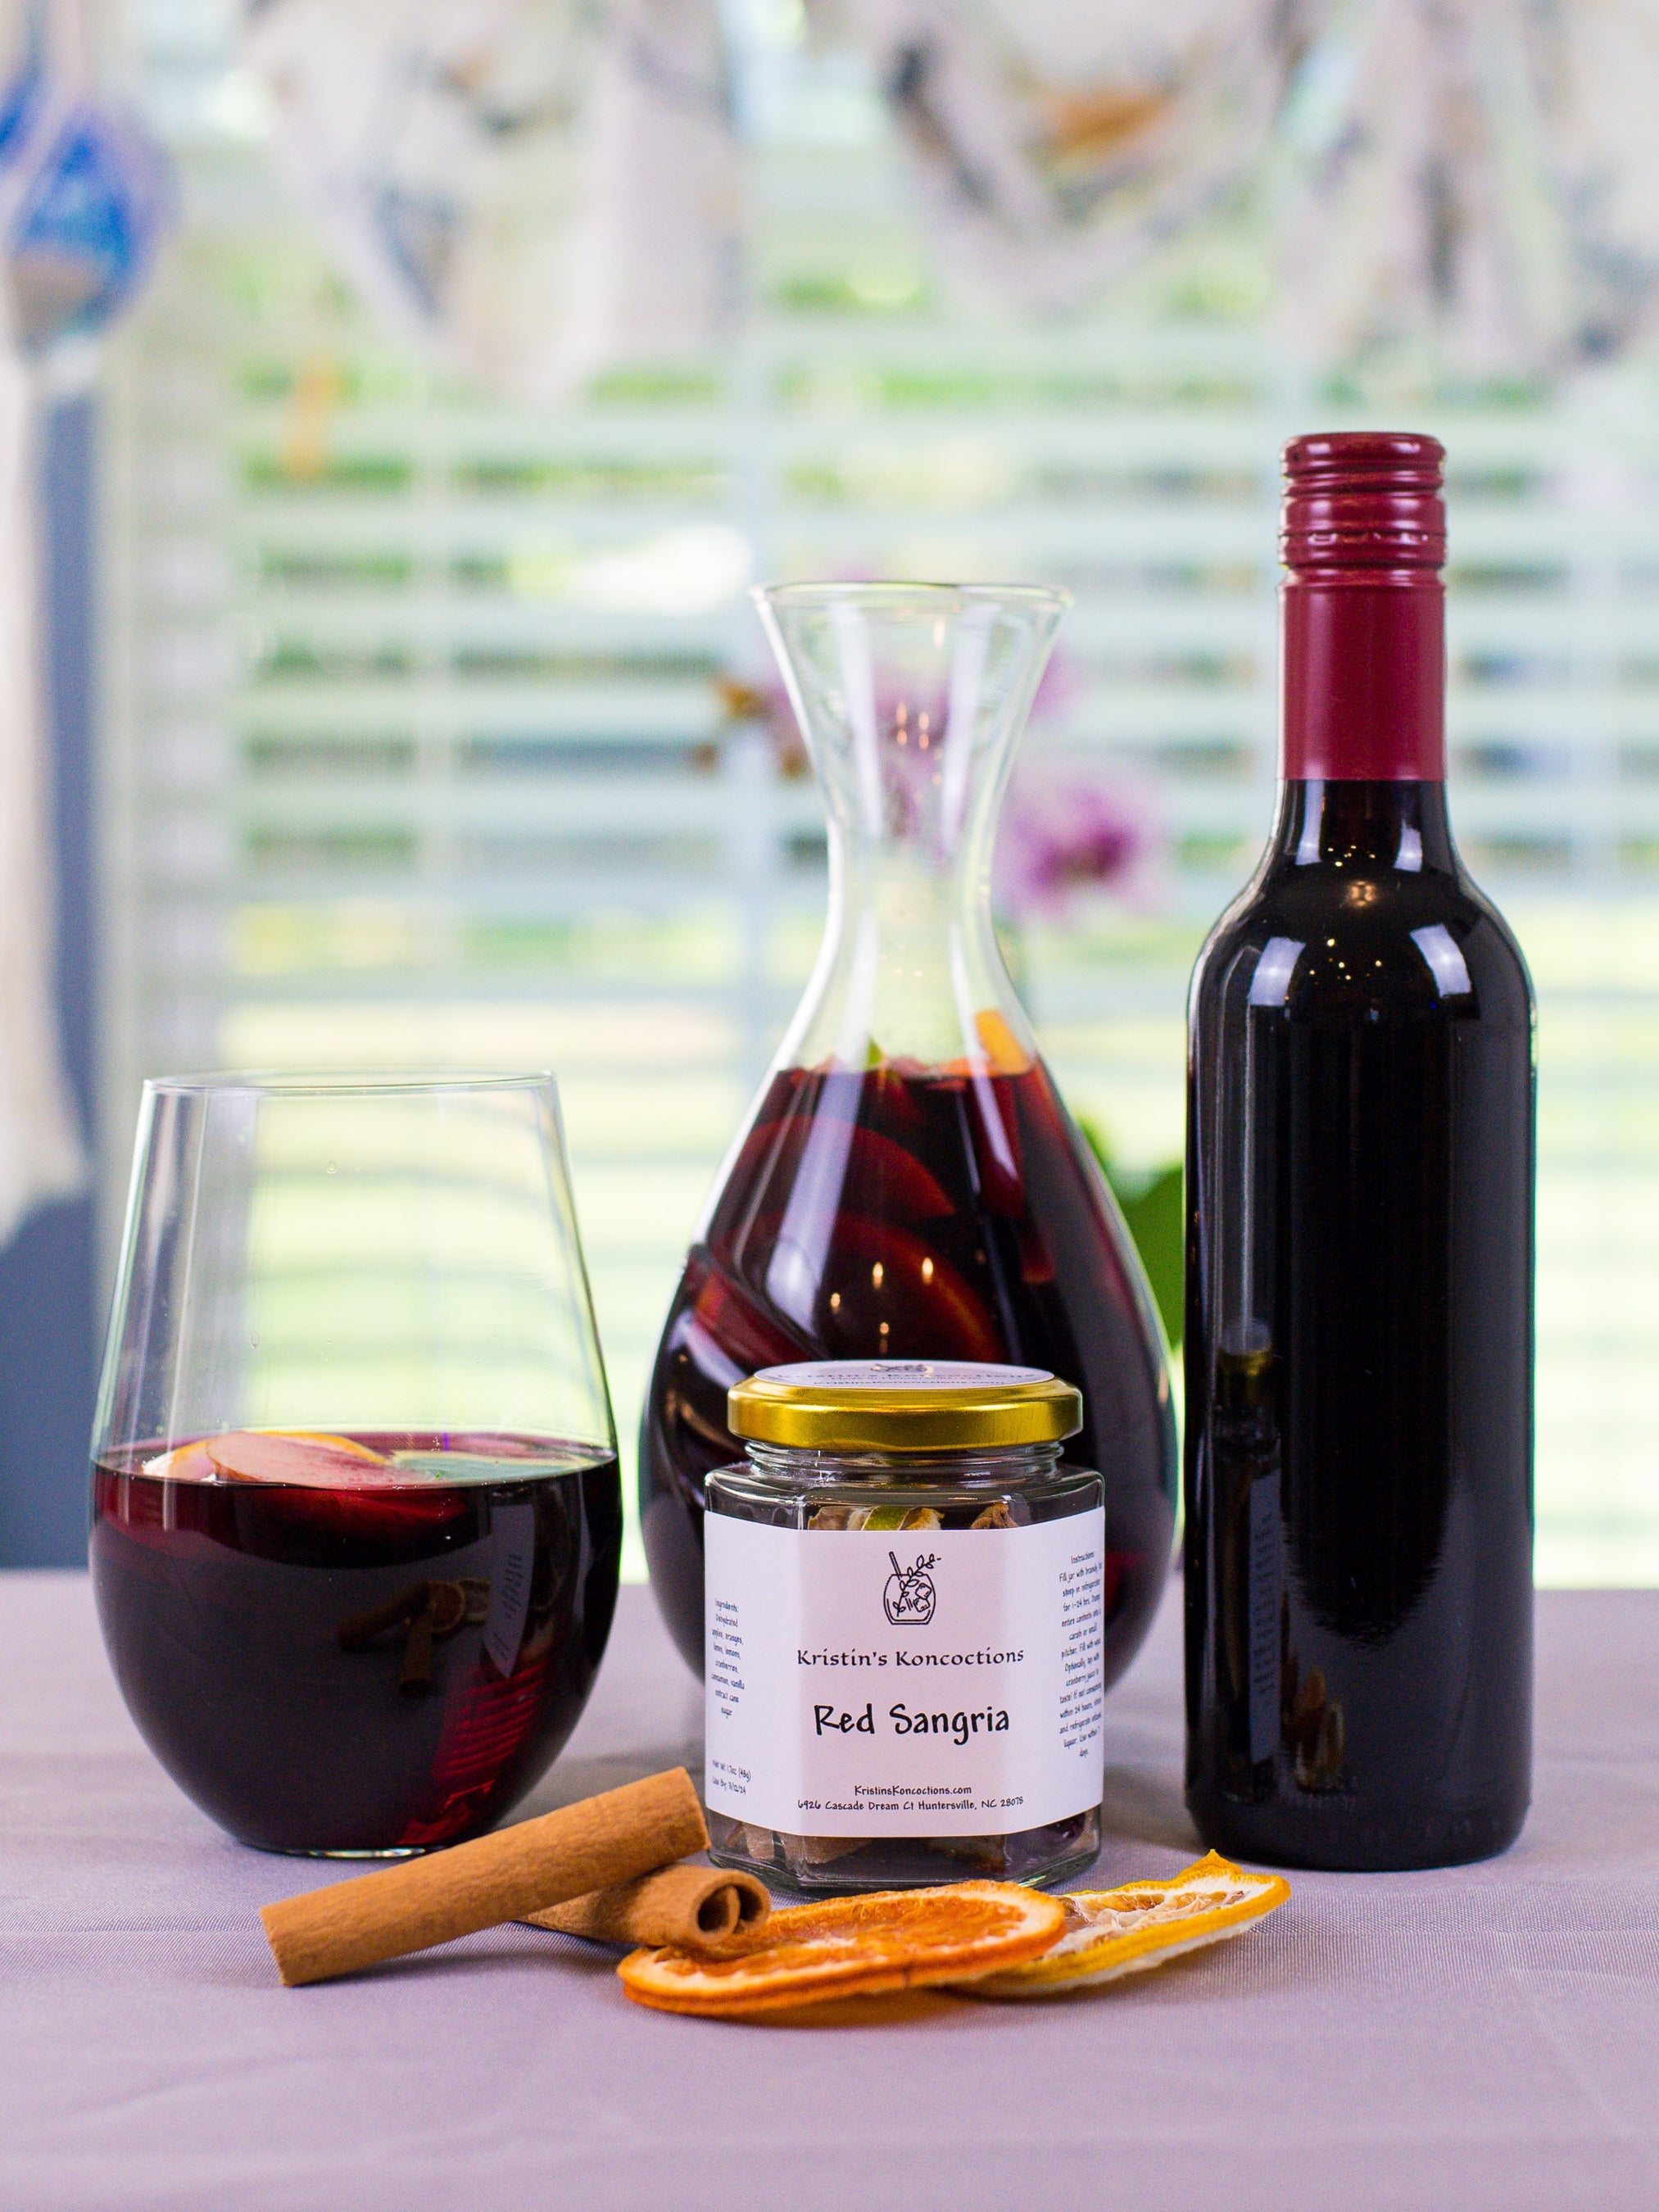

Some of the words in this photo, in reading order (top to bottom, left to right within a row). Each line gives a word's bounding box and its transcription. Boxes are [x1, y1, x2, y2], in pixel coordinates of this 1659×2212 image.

[797, 1648, 887, 1666] Kristin's
[895, 1647, 1024, 1666] Koncoctions
[814, 1702, 875, 1735] Red
[889, 1702, 1009, 1746] Sangria
[854, 1785, 972, 1796] KristinsKoncoctions.com
[798, 1799, 822, 1810] 6926
[825, 1801, 864, 1811] Cascade
[868, 1801, 900, 1811] Dream
[918, 1800, 977, 1811] Huntersville,
[981, 1798, 997, 1808] NC
[1000, 1796, 1024, 1807] 28078
